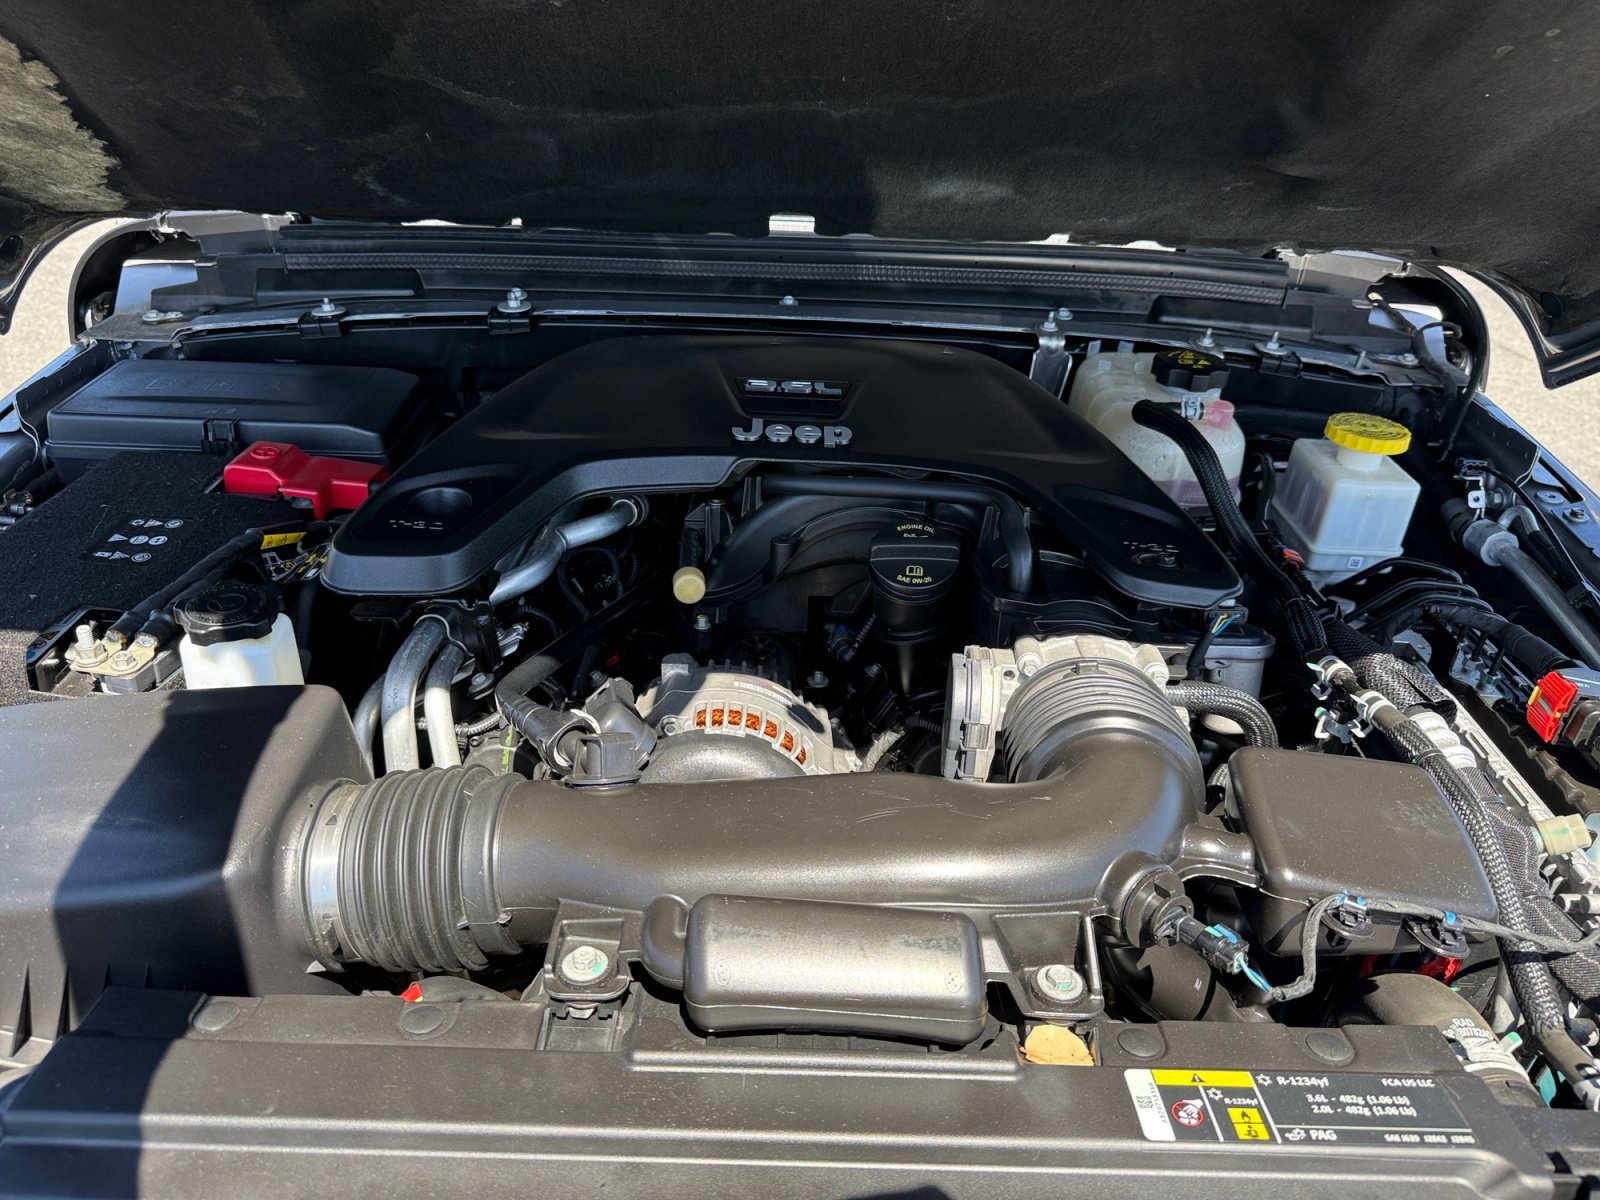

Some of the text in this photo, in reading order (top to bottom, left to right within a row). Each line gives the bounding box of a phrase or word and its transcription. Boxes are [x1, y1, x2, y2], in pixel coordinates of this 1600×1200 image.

[731, 417, 853, 448] Jeep
[896, 524, 935, 534] ENGINE OIL
[896, 574, 933, 584] SAE 0W-20
[1452, 1018, 1475, 1027] RAD
[1276, 1076, 1329, 1088] R-1234yf
[1381, 1078, 1435, 1088] FCA US LLC
[1223, 1098, 1258, 1106] R-1234yf
[1305, 1094, 1328, 1103] 3.6L
[1339, 1095, 1365, 1105] 482g
[1367, 1095, 1394, 1105] (1.06
[1311, 1105, 1334, 1113] 2.0L
[1345, 1106, 1371, 1116] 482g
[1372, 1106, 1399, 1116] (1.06
[1309, 1130, 1337, 1141] PAG
[1384, 1133, 1400, 1142] SAE
